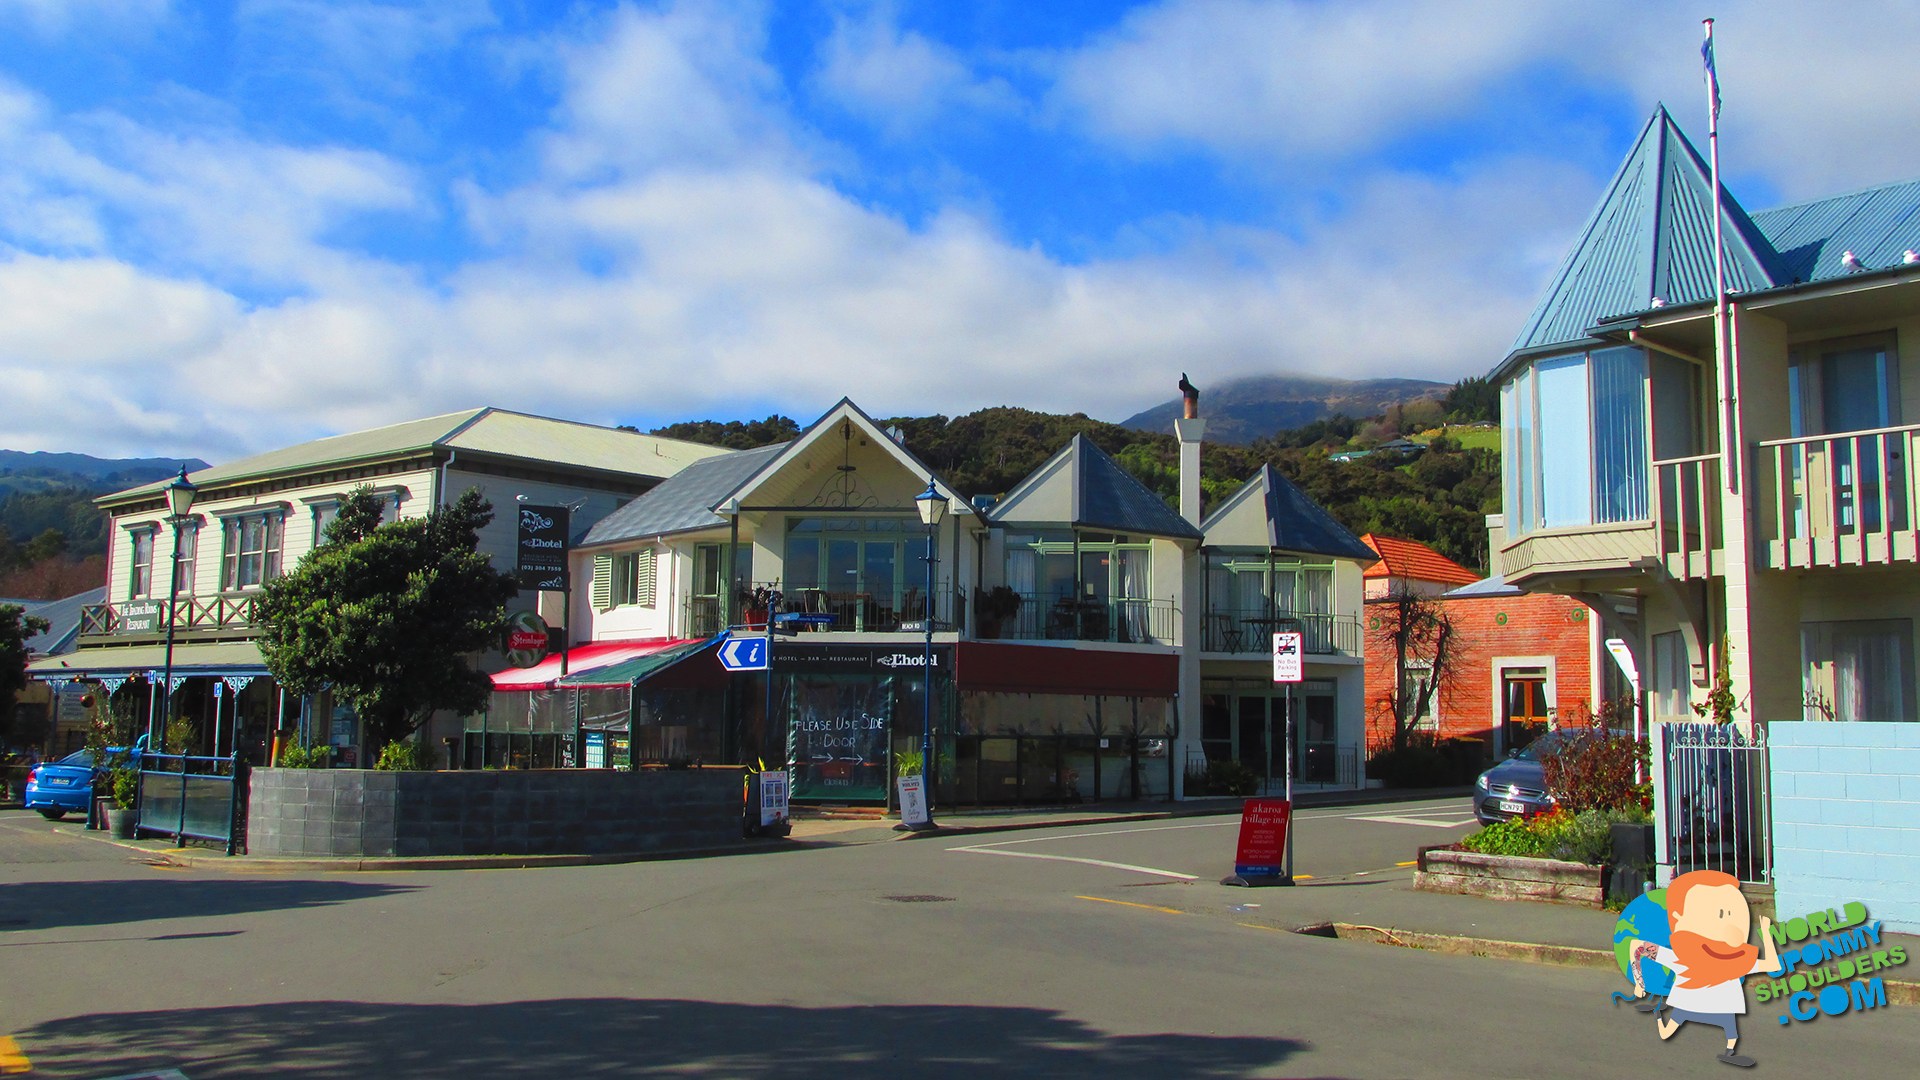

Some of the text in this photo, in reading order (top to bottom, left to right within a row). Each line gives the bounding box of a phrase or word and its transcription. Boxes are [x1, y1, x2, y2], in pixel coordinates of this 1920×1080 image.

[531, 538, 563, 549] L'hotel
[795, 720, 832, 731] PLEASE
[823, 733, 856, 748] DOOR
[1252, 803, 1282, 814] akaroa
[1245, 814, 1286, 826] village inn
